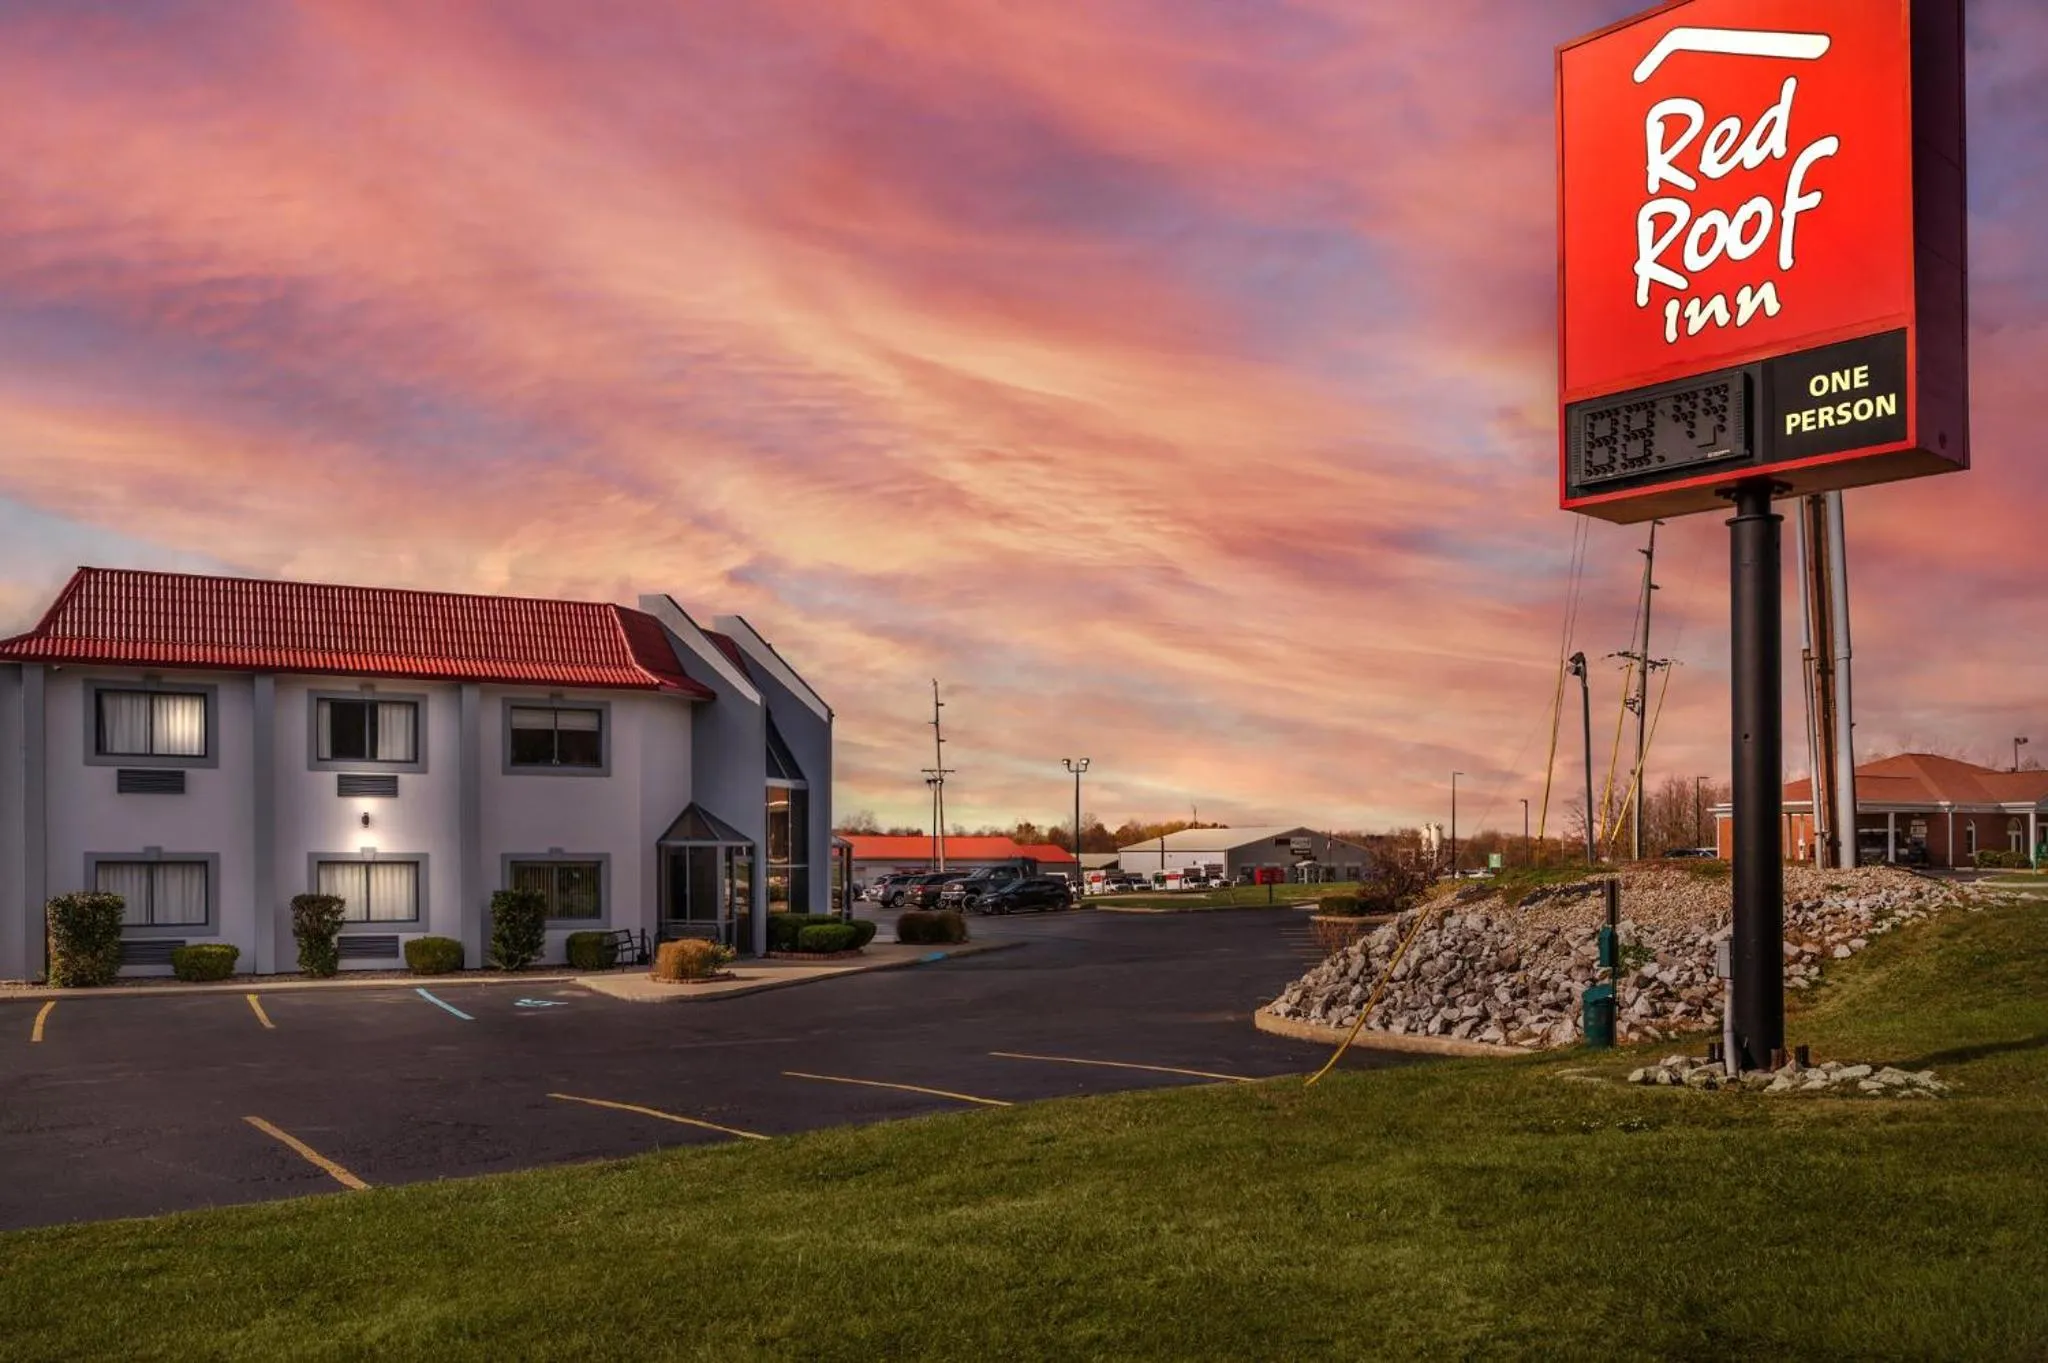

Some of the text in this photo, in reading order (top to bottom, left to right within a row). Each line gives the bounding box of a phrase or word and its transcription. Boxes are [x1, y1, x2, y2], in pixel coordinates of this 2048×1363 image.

[1645, 76, 1797, 195] Red
[1633, 135, 1839, 307] Roof
[1785, 393, 1897, 435] PERSON
[1809, 365, 1869, 397] ONE
